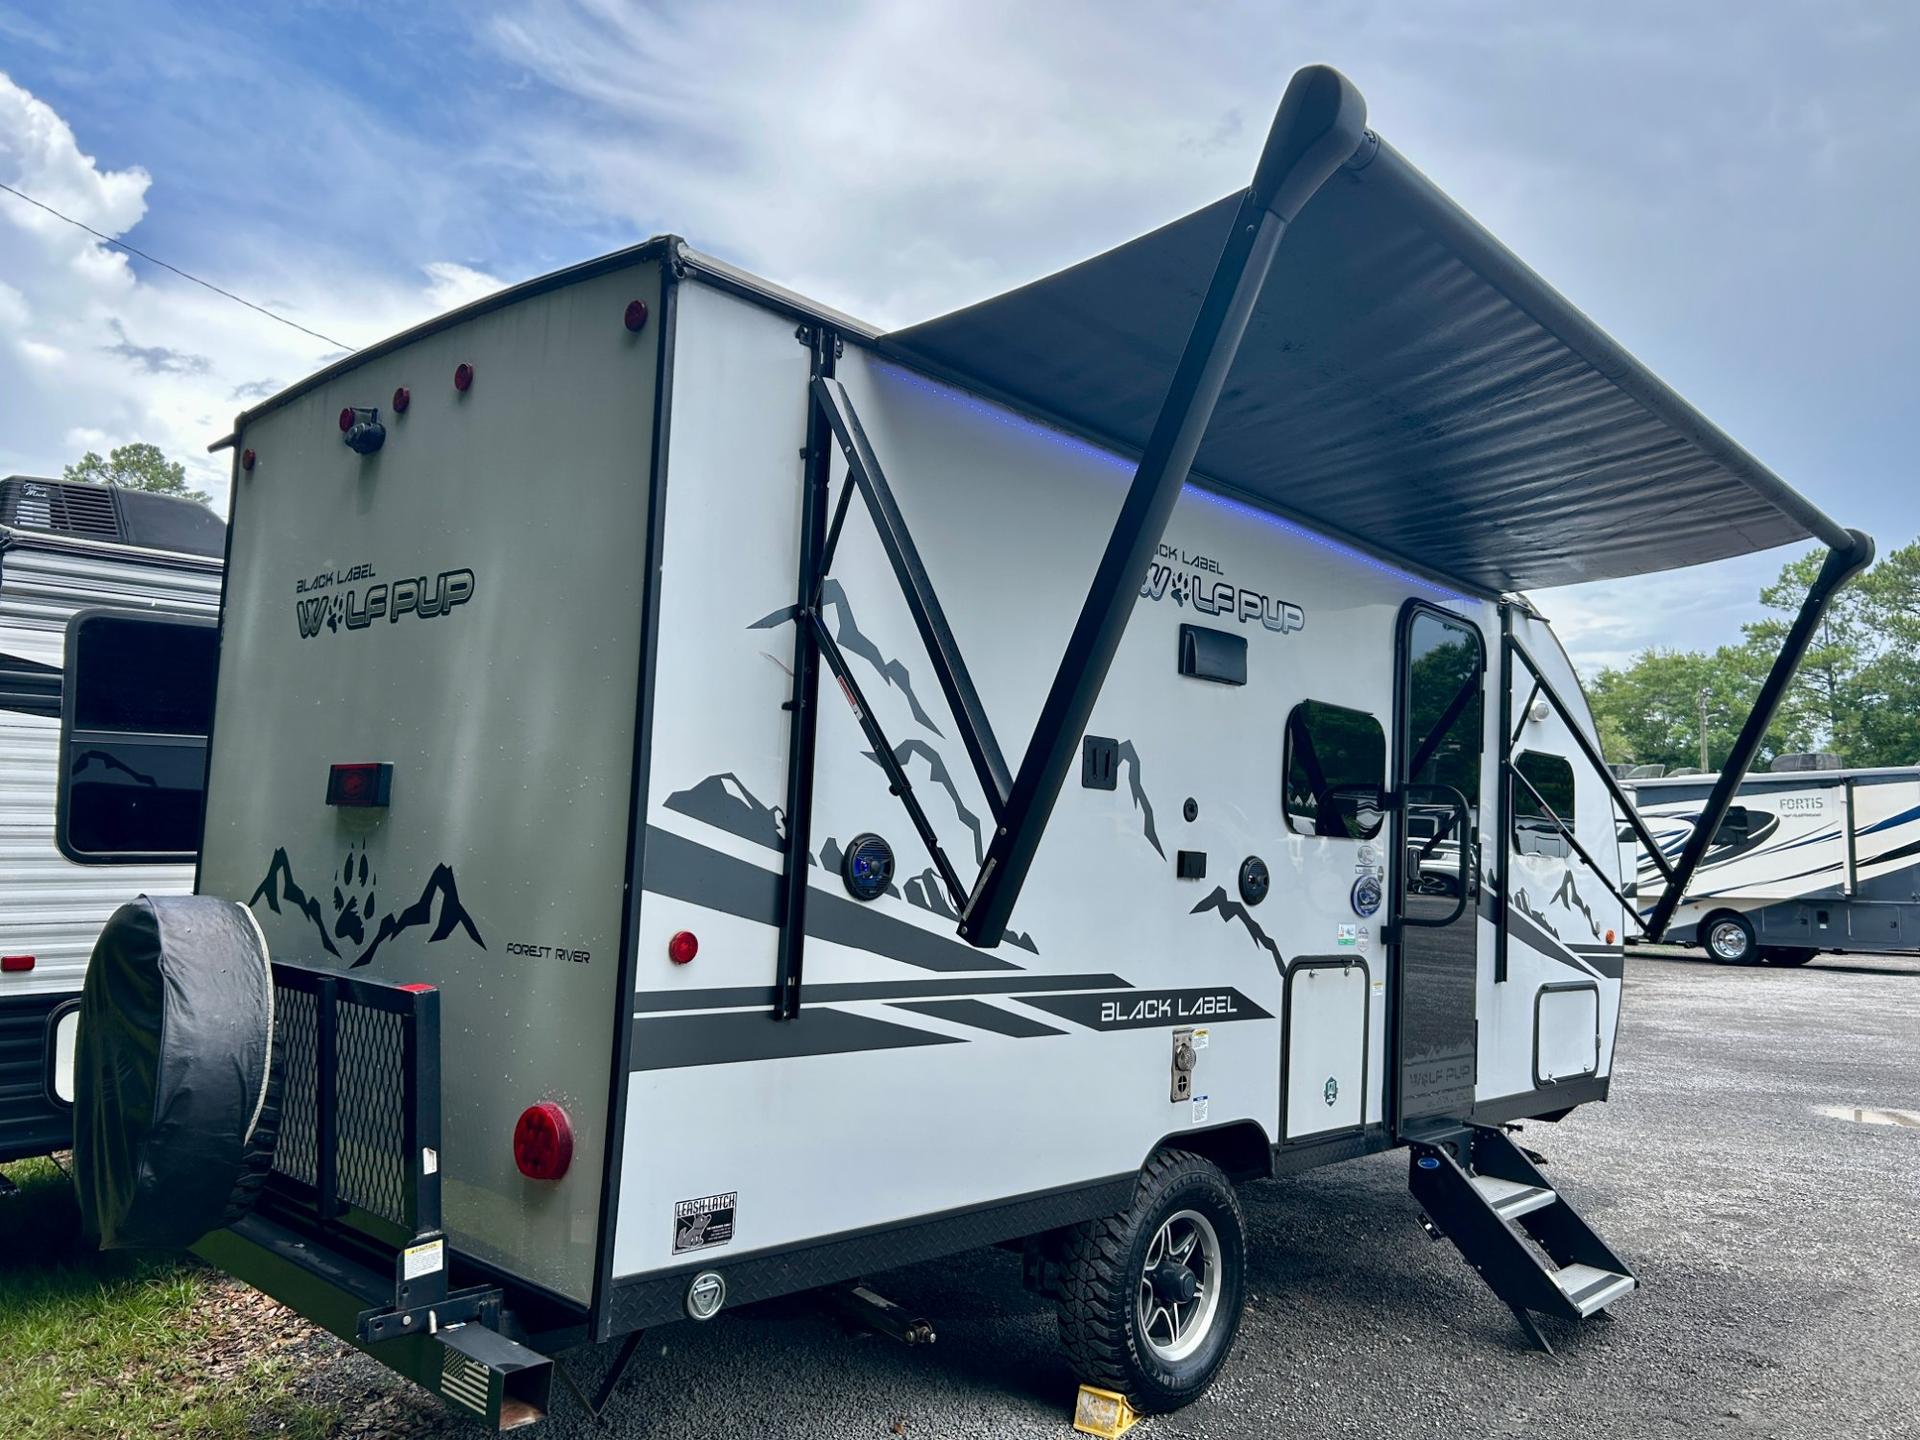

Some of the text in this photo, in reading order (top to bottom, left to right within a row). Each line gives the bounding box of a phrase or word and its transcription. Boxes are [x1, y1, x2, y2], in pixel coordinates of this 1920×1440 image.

[1182, 551, 1224, 575] LABEL
[296, 563, 376, 593] BLACK LABEL
[390, 567, 475, 624] PUP
[1238, 588, 1306, 635] PUP
[1780, 797, 1823, 810] FORTIS
[506, 943, 591, 964] FOREST RIVER
[1101, 995, 1238, 1022] BLACK LABEL
